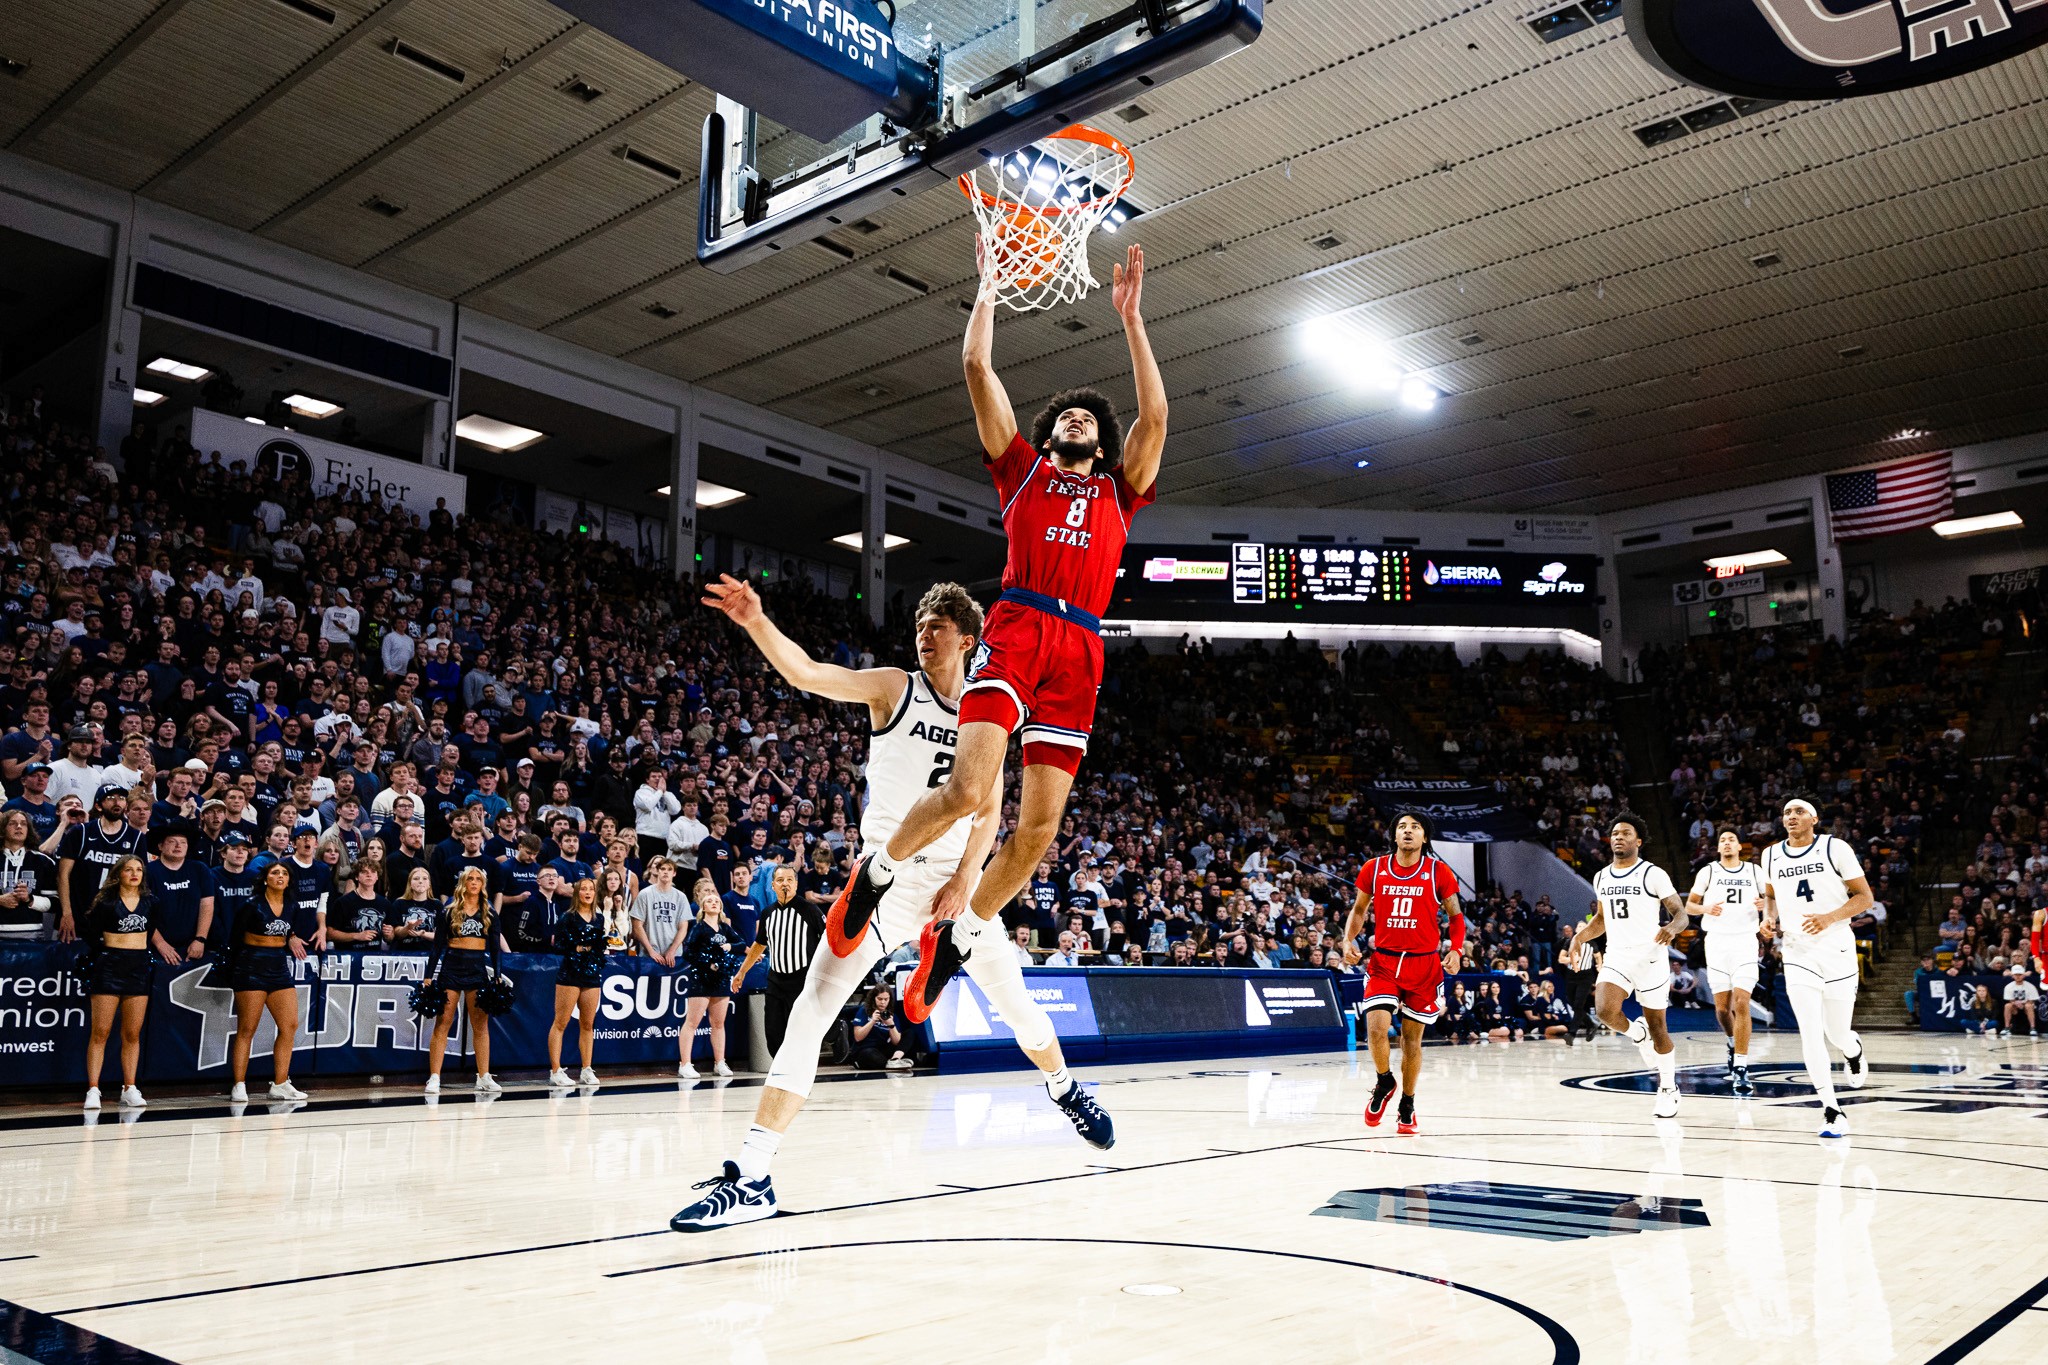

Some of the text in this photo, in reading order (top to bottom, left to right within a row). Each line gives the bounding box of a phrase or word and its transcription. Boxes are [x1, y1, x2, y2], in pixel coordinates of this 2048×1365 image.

[818, 0, 893, 59] FIRST
[806, 20, 874, 70] UNION
[273, 450, 298, 482] F
[322, 457, 411, 502] Fisher
[1065, 497, 1088, 528] 8
[1176, 566, 1225, 574] LES SCHWAB
[1440, 565, 1501, 580] SIERRA
[1989, 568, 2040, 585] AGGIE
[1522, 580, 1585, 596] Sign Pro
[927, 751, 956, 789] 2
[1374, 780, 1472, 789] UTAH STATE
[1778, 862, 1825, 880] AGGIES
[1717, 878, 1752, 887] AGGIES
[1382, 885, 1424, 897] FRESNO
[1600, 886, 1641, 896] AGGIES
[1726, 888, 1742, 904] 21
[1796, 879, 1815, 903] 4
[652, 902, 677, 911] CLUB
[1391, 897, 1413, 917] 10
[1609, 898, 1629, 920] 13
[1386, 918, 1418, 929] STATE
[0, 1001, 85, 1028] nion
[631, 1027, 641, 1039] of
[0, 1039, 55, 1053] nwest
